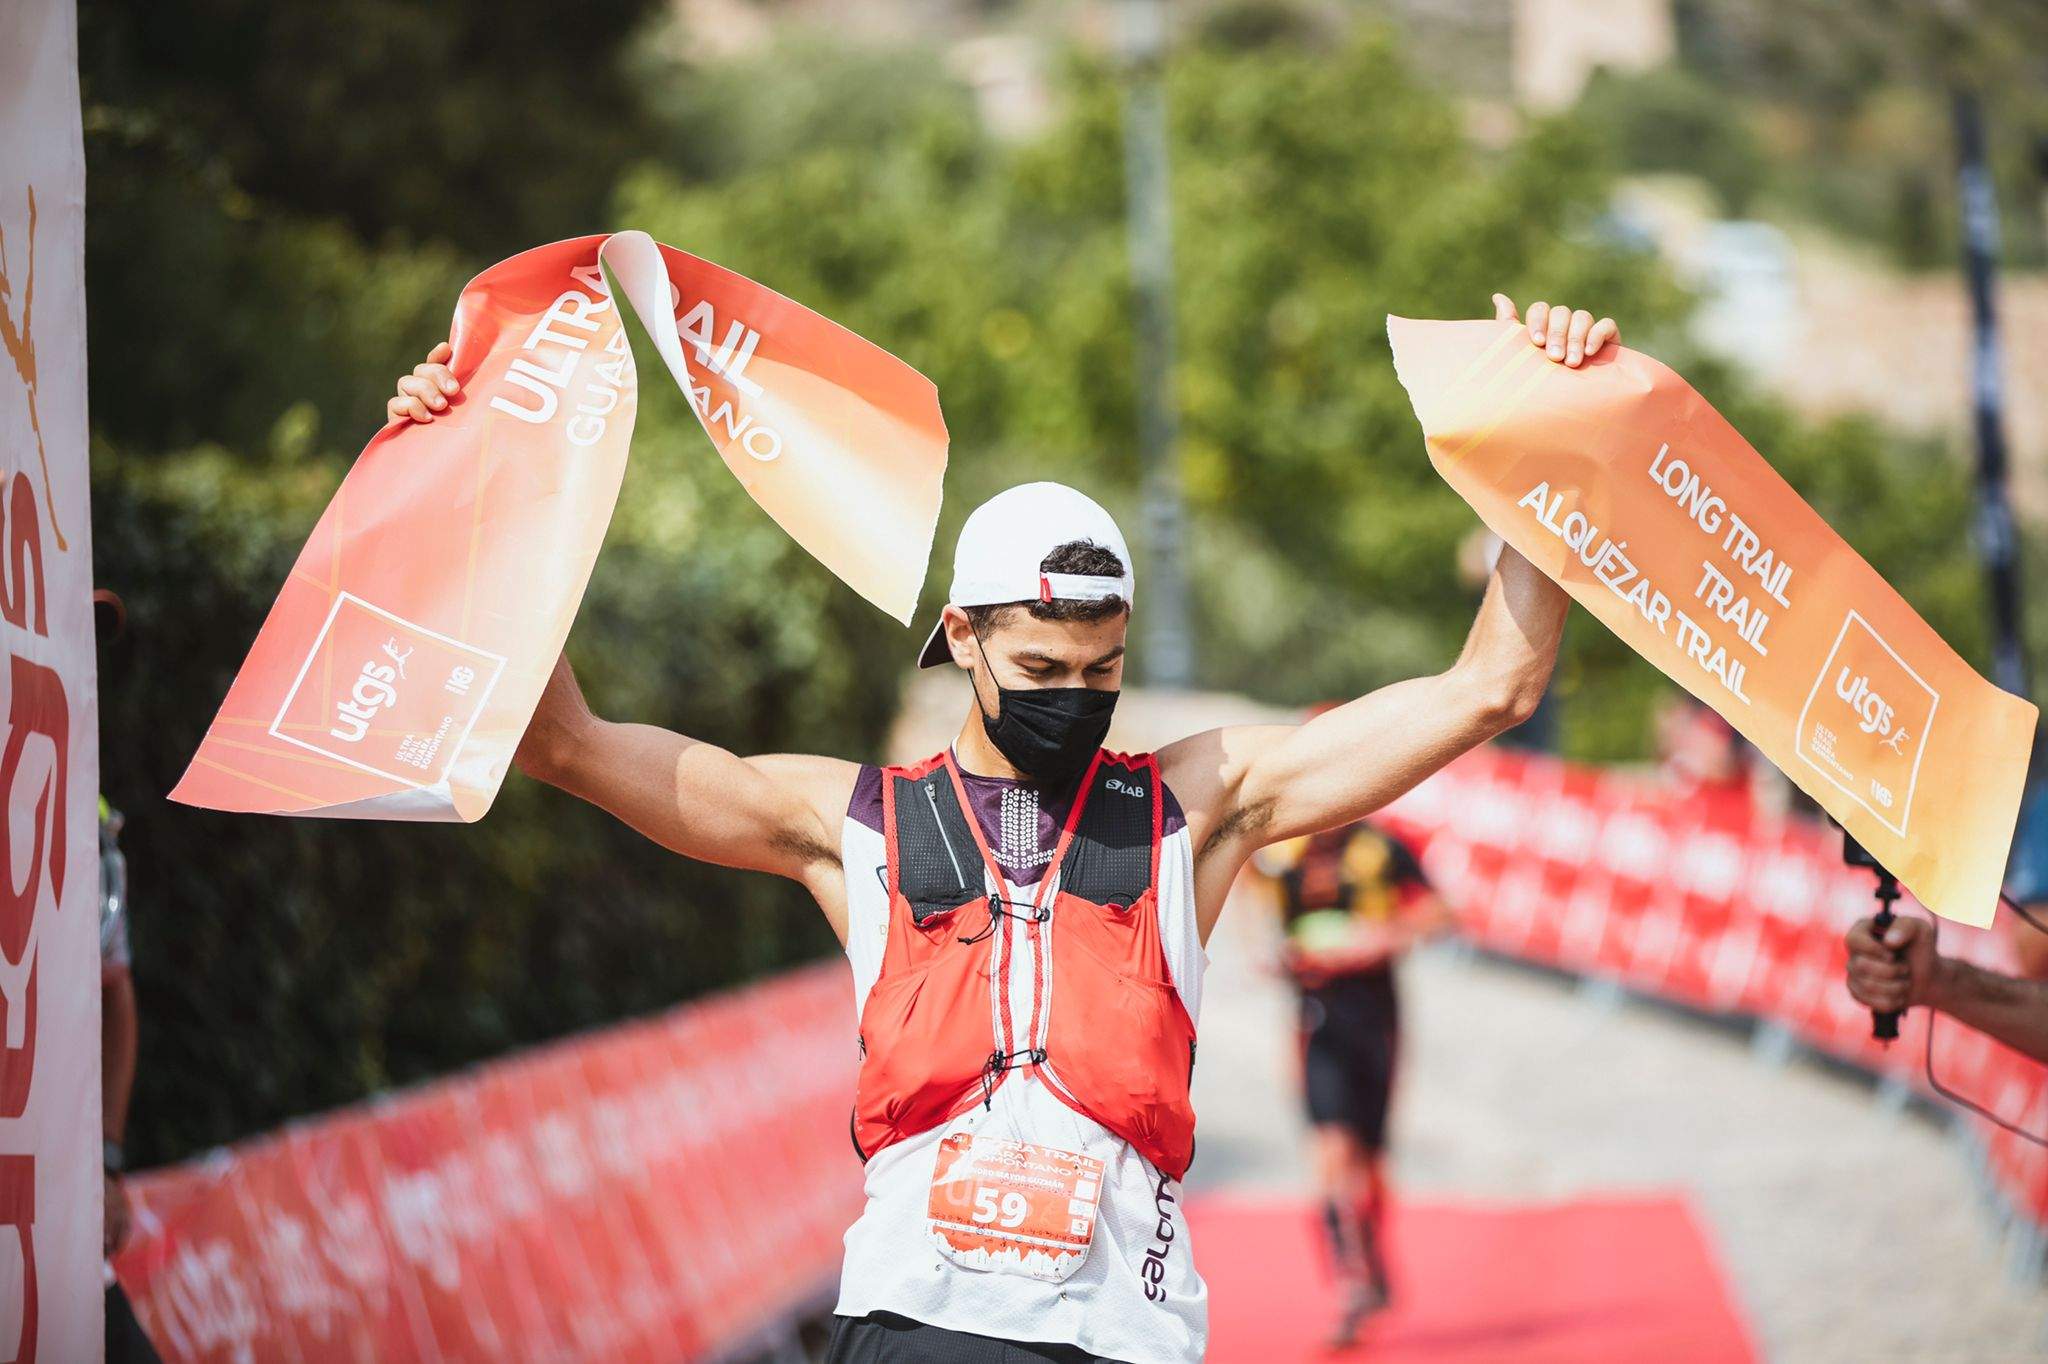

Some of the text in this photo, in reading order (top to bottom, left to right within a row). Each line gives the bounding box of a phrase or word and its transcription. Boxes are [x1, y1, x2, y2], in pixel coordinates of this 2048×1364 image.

[1648, 443, 1793, 609] LONG TRAIL
[1517, 481, 1751, 706] ALQUÉZAR TRAIL
[1694, 560, 1769, 656] TRAIL
[330, 661, 397, 742] utgs
[1836, 666, 1895, 735] utgs
[981, 1154, 1072, 1176] OMONTANO
[1043, 1148, 1102, 1170] TRAIL
[972, 1187, 1028, 1227] 59
[1142, 1164, 1175, 1302] salom
